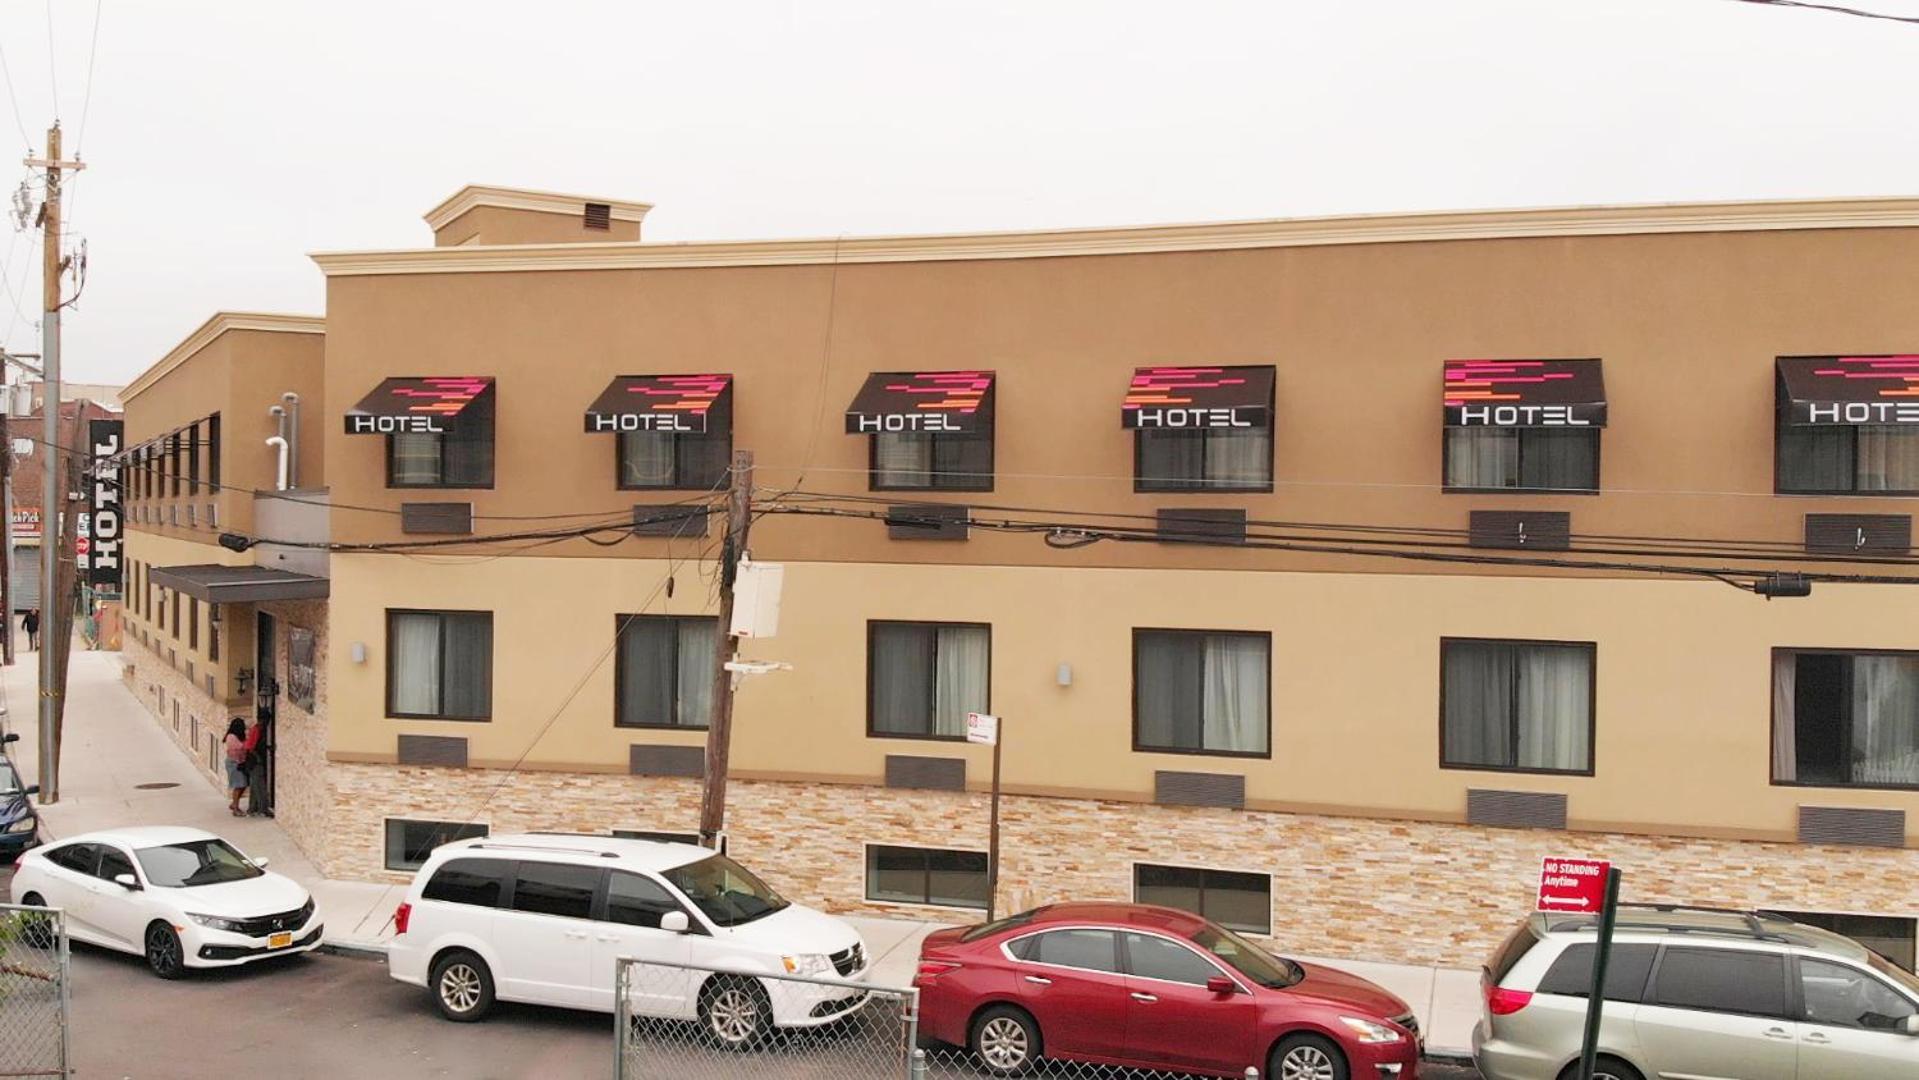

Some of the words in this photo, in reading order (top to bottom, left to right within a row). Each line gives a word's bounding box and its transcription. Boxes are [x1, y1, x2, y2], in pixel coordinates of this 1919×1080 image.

[1138, 408, 1251, 427] HOTEL
[1462, 406, 1590, 425] HOTEL
[1810, 402, 1919, 423] HOTE
[355, 416, 443, 432] HOTEL
[597, 414, 691, 431] HOTEL
[860, 414, 962, 431] HOTEL
[96, 434, 118, 569] HOTEL
[1546, 863, 1558, 874] NO
[1559, 863, 1600, 876] STANDING
[1544, 875, 1579, 888] Anytime
